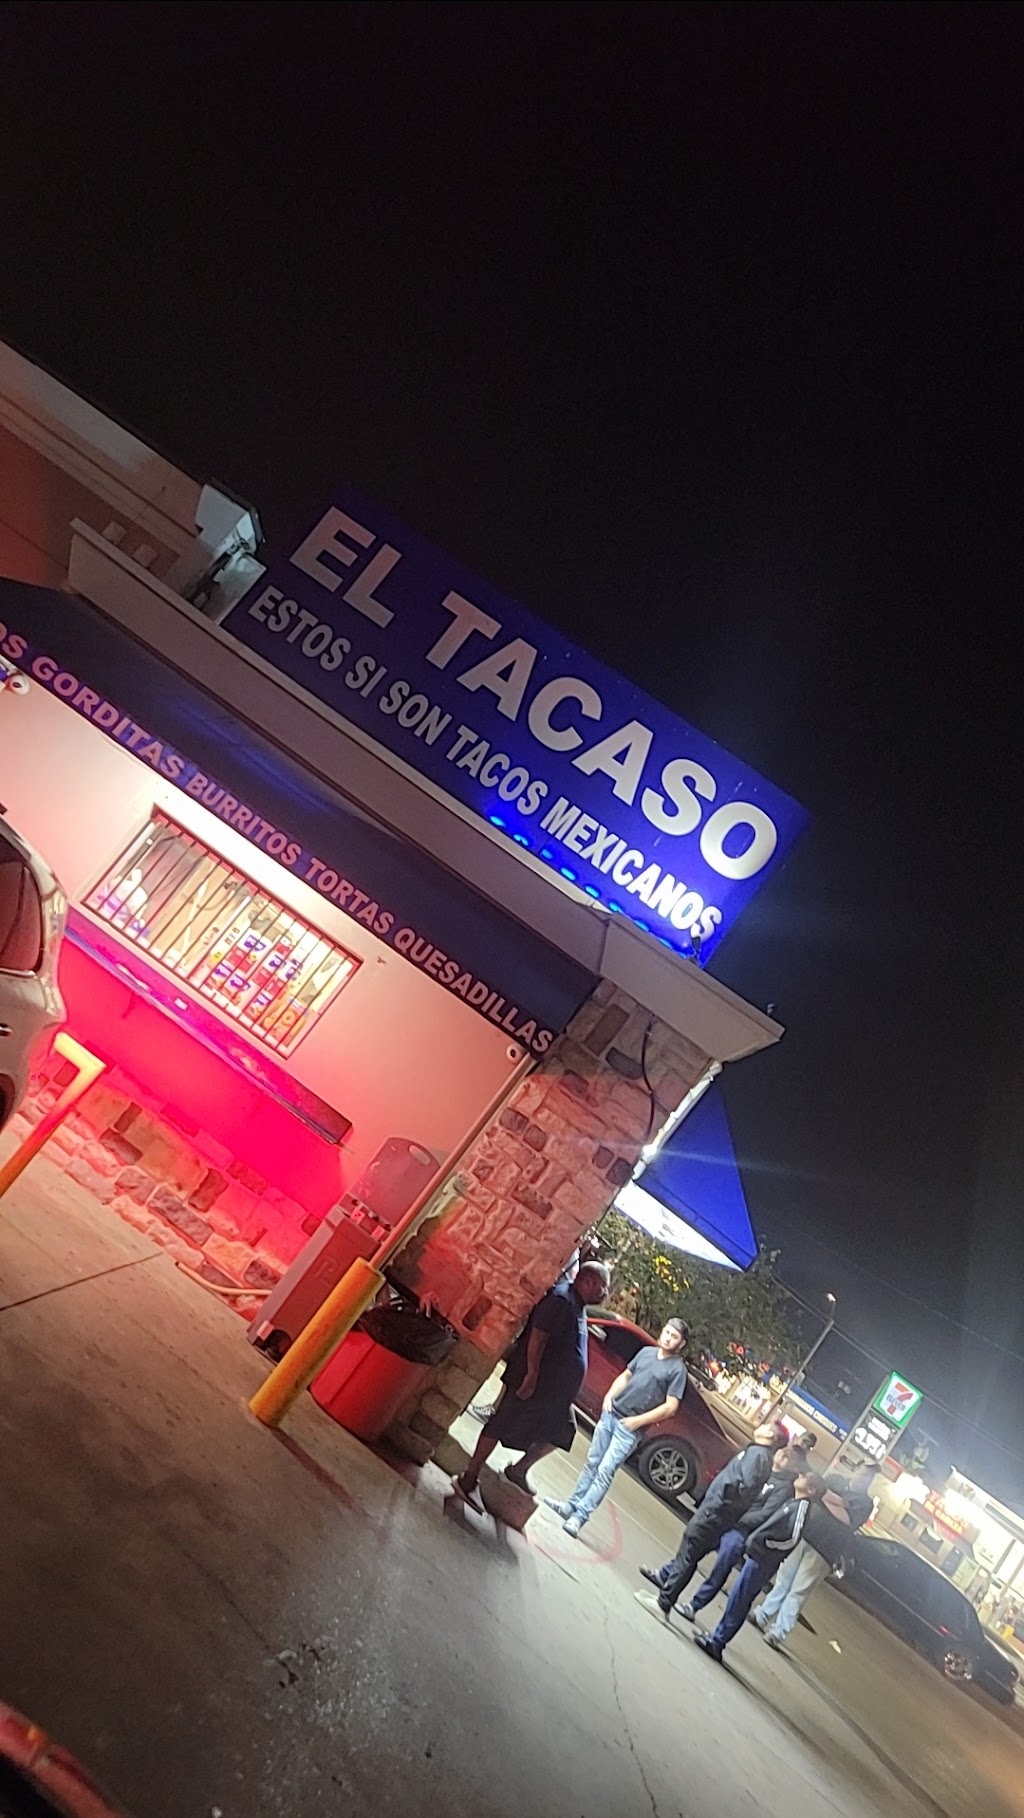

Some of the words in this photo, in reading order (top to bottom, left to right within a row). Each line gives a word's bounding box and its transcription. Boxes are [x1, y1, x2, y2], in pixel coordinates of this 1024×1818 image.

[31, 656, 185, 778] GORDITAS
[185, 773, 301, 865] BURRITOS
[305, 857, 394, 934] TORTAS
[394, 928, 554, 1052] QUESADILLAS
[248, 585, 351, 671] ESTOS
[345, 656, 388, 697] SI
[379, 680, 452, 745] SON
[445, 725, 548, 815] TACOS
[540, 797, 722, 942] MEXICANOS
[289, 506, 402, 628] EL
[425, 590, 778, 880] TACASO
